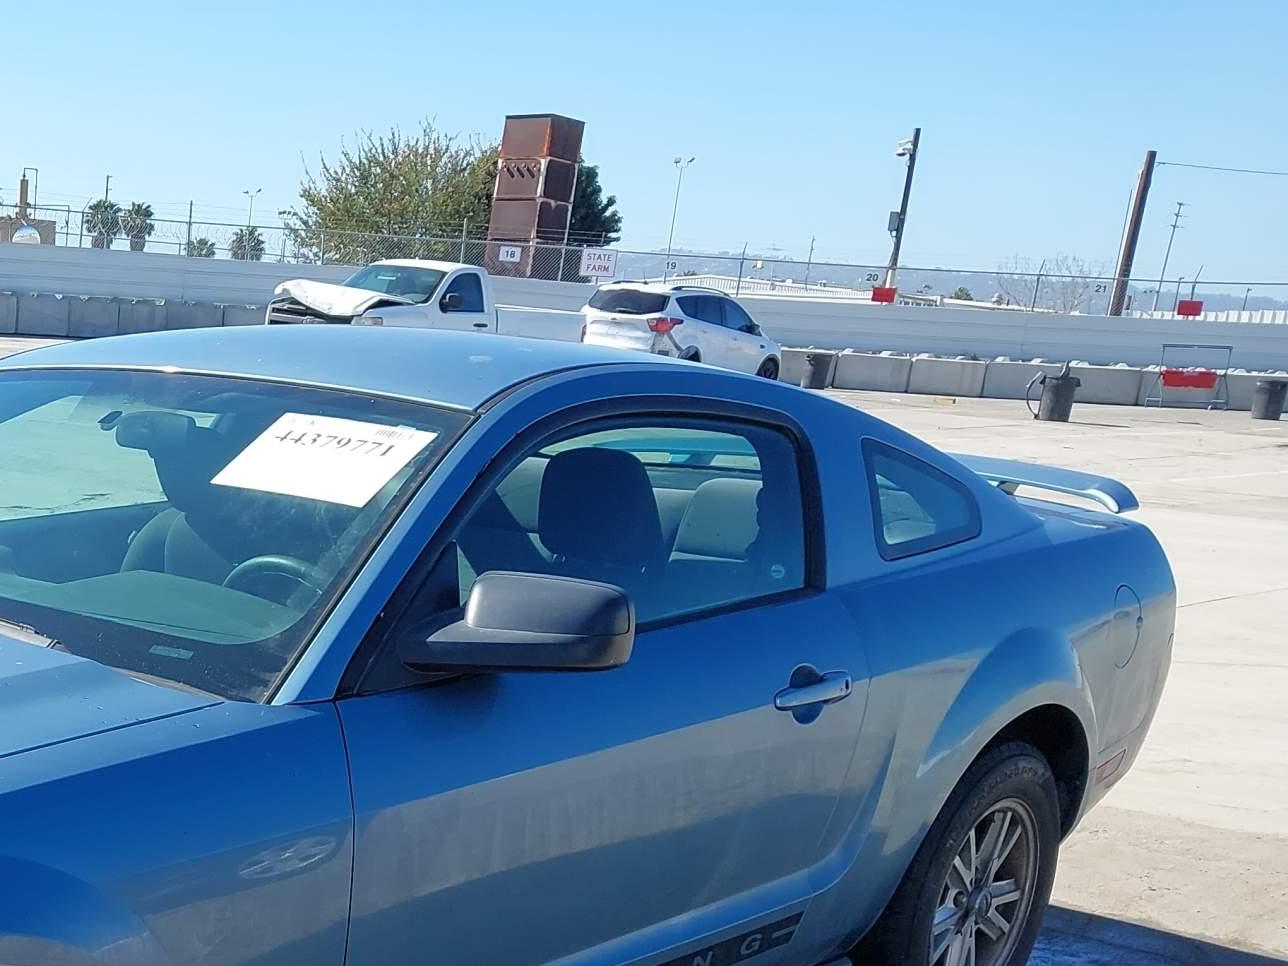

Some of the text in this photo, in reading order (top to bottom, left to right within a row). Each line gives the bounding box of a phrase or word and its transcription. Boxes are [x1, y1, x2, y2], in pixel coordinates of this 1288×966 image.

[504, 249, 516, 259] 18
[586, 253, 612, 262] STATE
[585, 263, 610, 273] FARM
[665, 262, 677, 270] 19
[866, 273, 879, 282] 20
[1095, 284, 1107, 293] 21
[275, 430, 395, 456] 44379771
